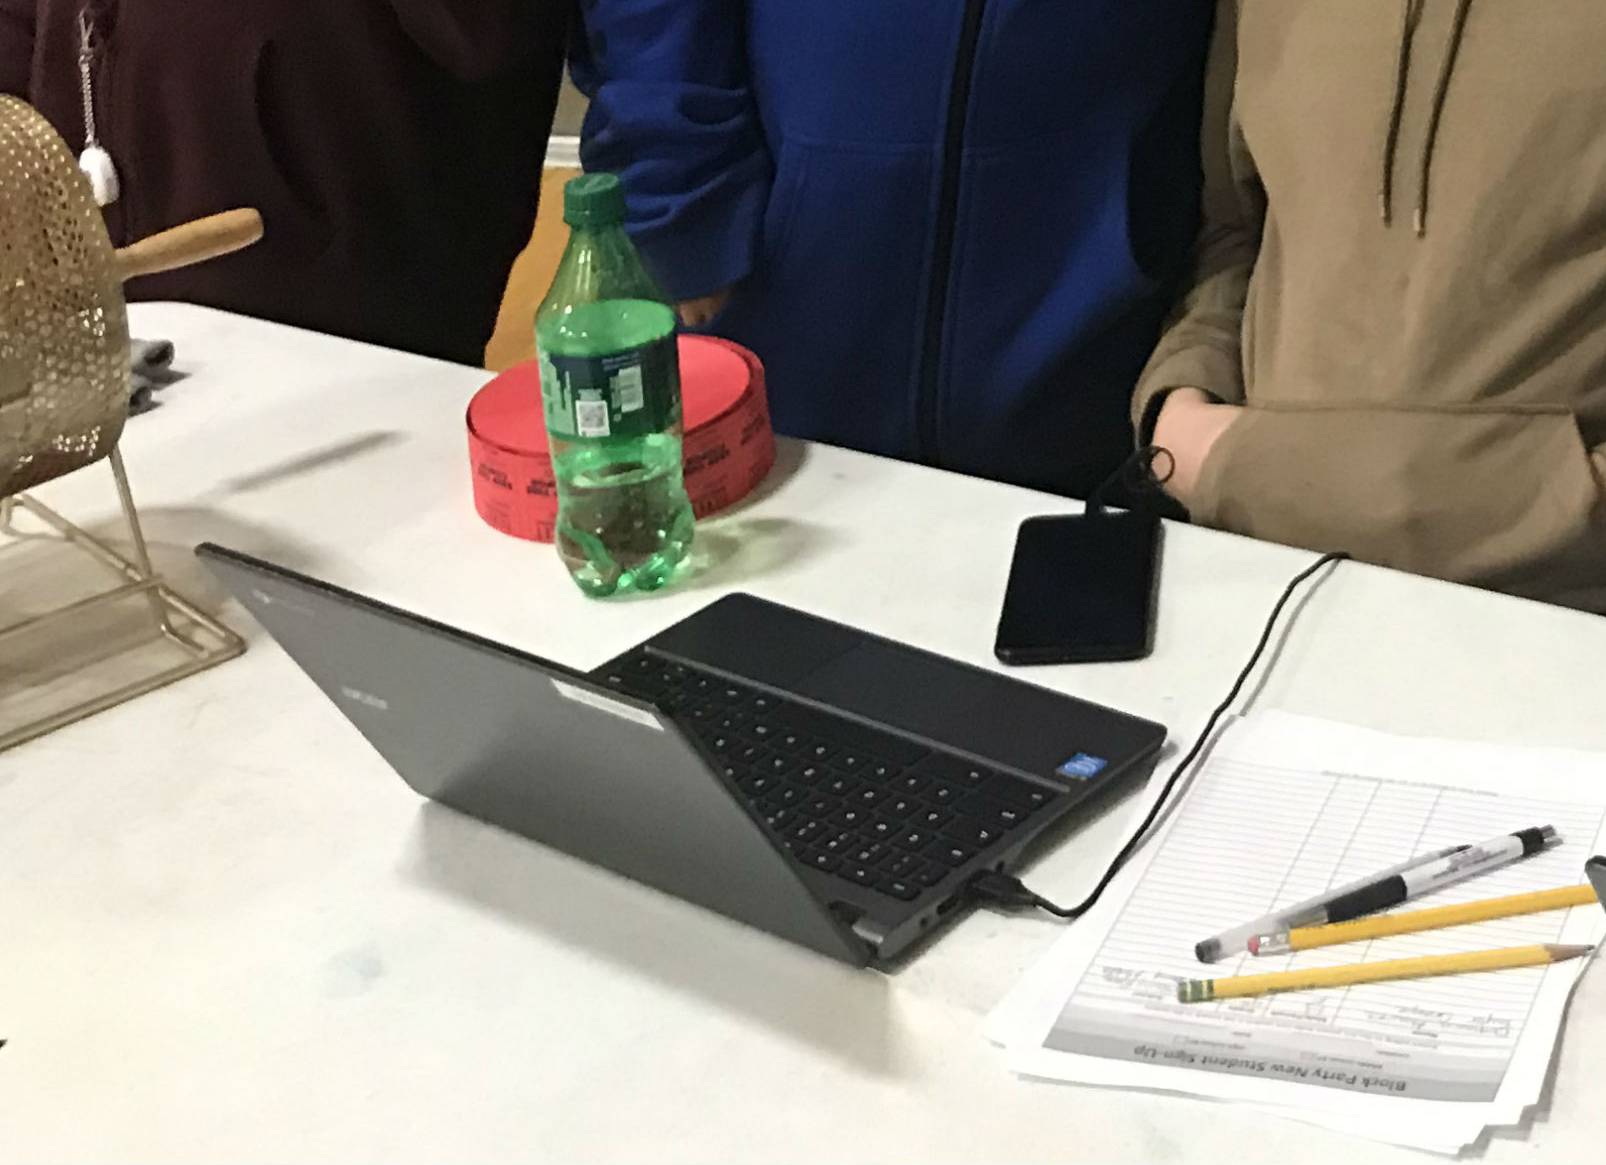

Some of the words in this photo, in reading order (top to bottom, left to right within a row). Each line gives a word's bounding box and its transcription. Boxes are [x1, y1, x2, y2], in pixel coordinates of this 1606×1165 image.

[1200, 1054, 1267, 1077] Student
[1270, 1063, 1311, 1082] New
[1311, 1067, 1359, 1088] Party
[1356, 1076, 1407, 1094] Block
